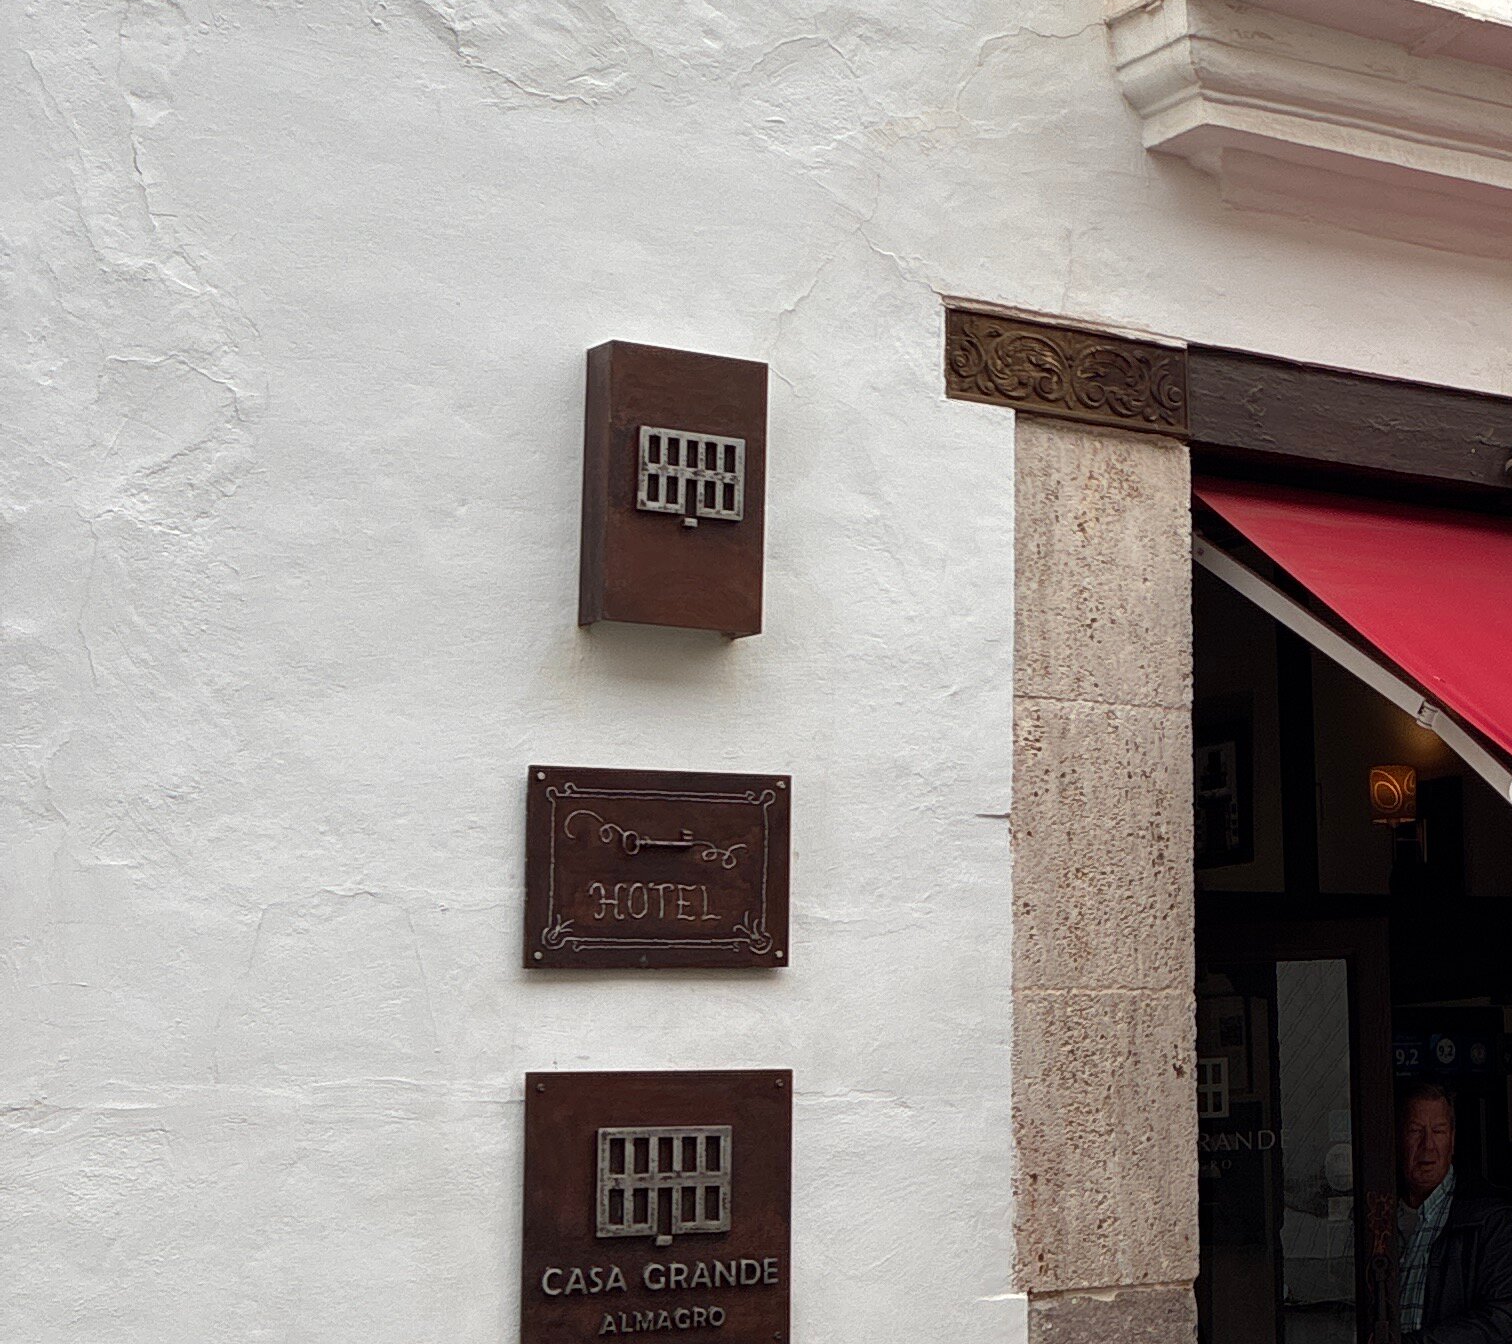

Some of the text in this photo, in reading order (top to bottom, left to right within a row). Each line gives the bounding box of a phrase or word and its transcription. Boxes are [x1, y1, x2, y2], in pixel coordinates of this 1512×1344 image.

[589, 882, 722, 921] HOTEL
[541, 1257, 780, 1296] CASA GRANDE
[599, 1306, 727, 1335] ALMAGRO
